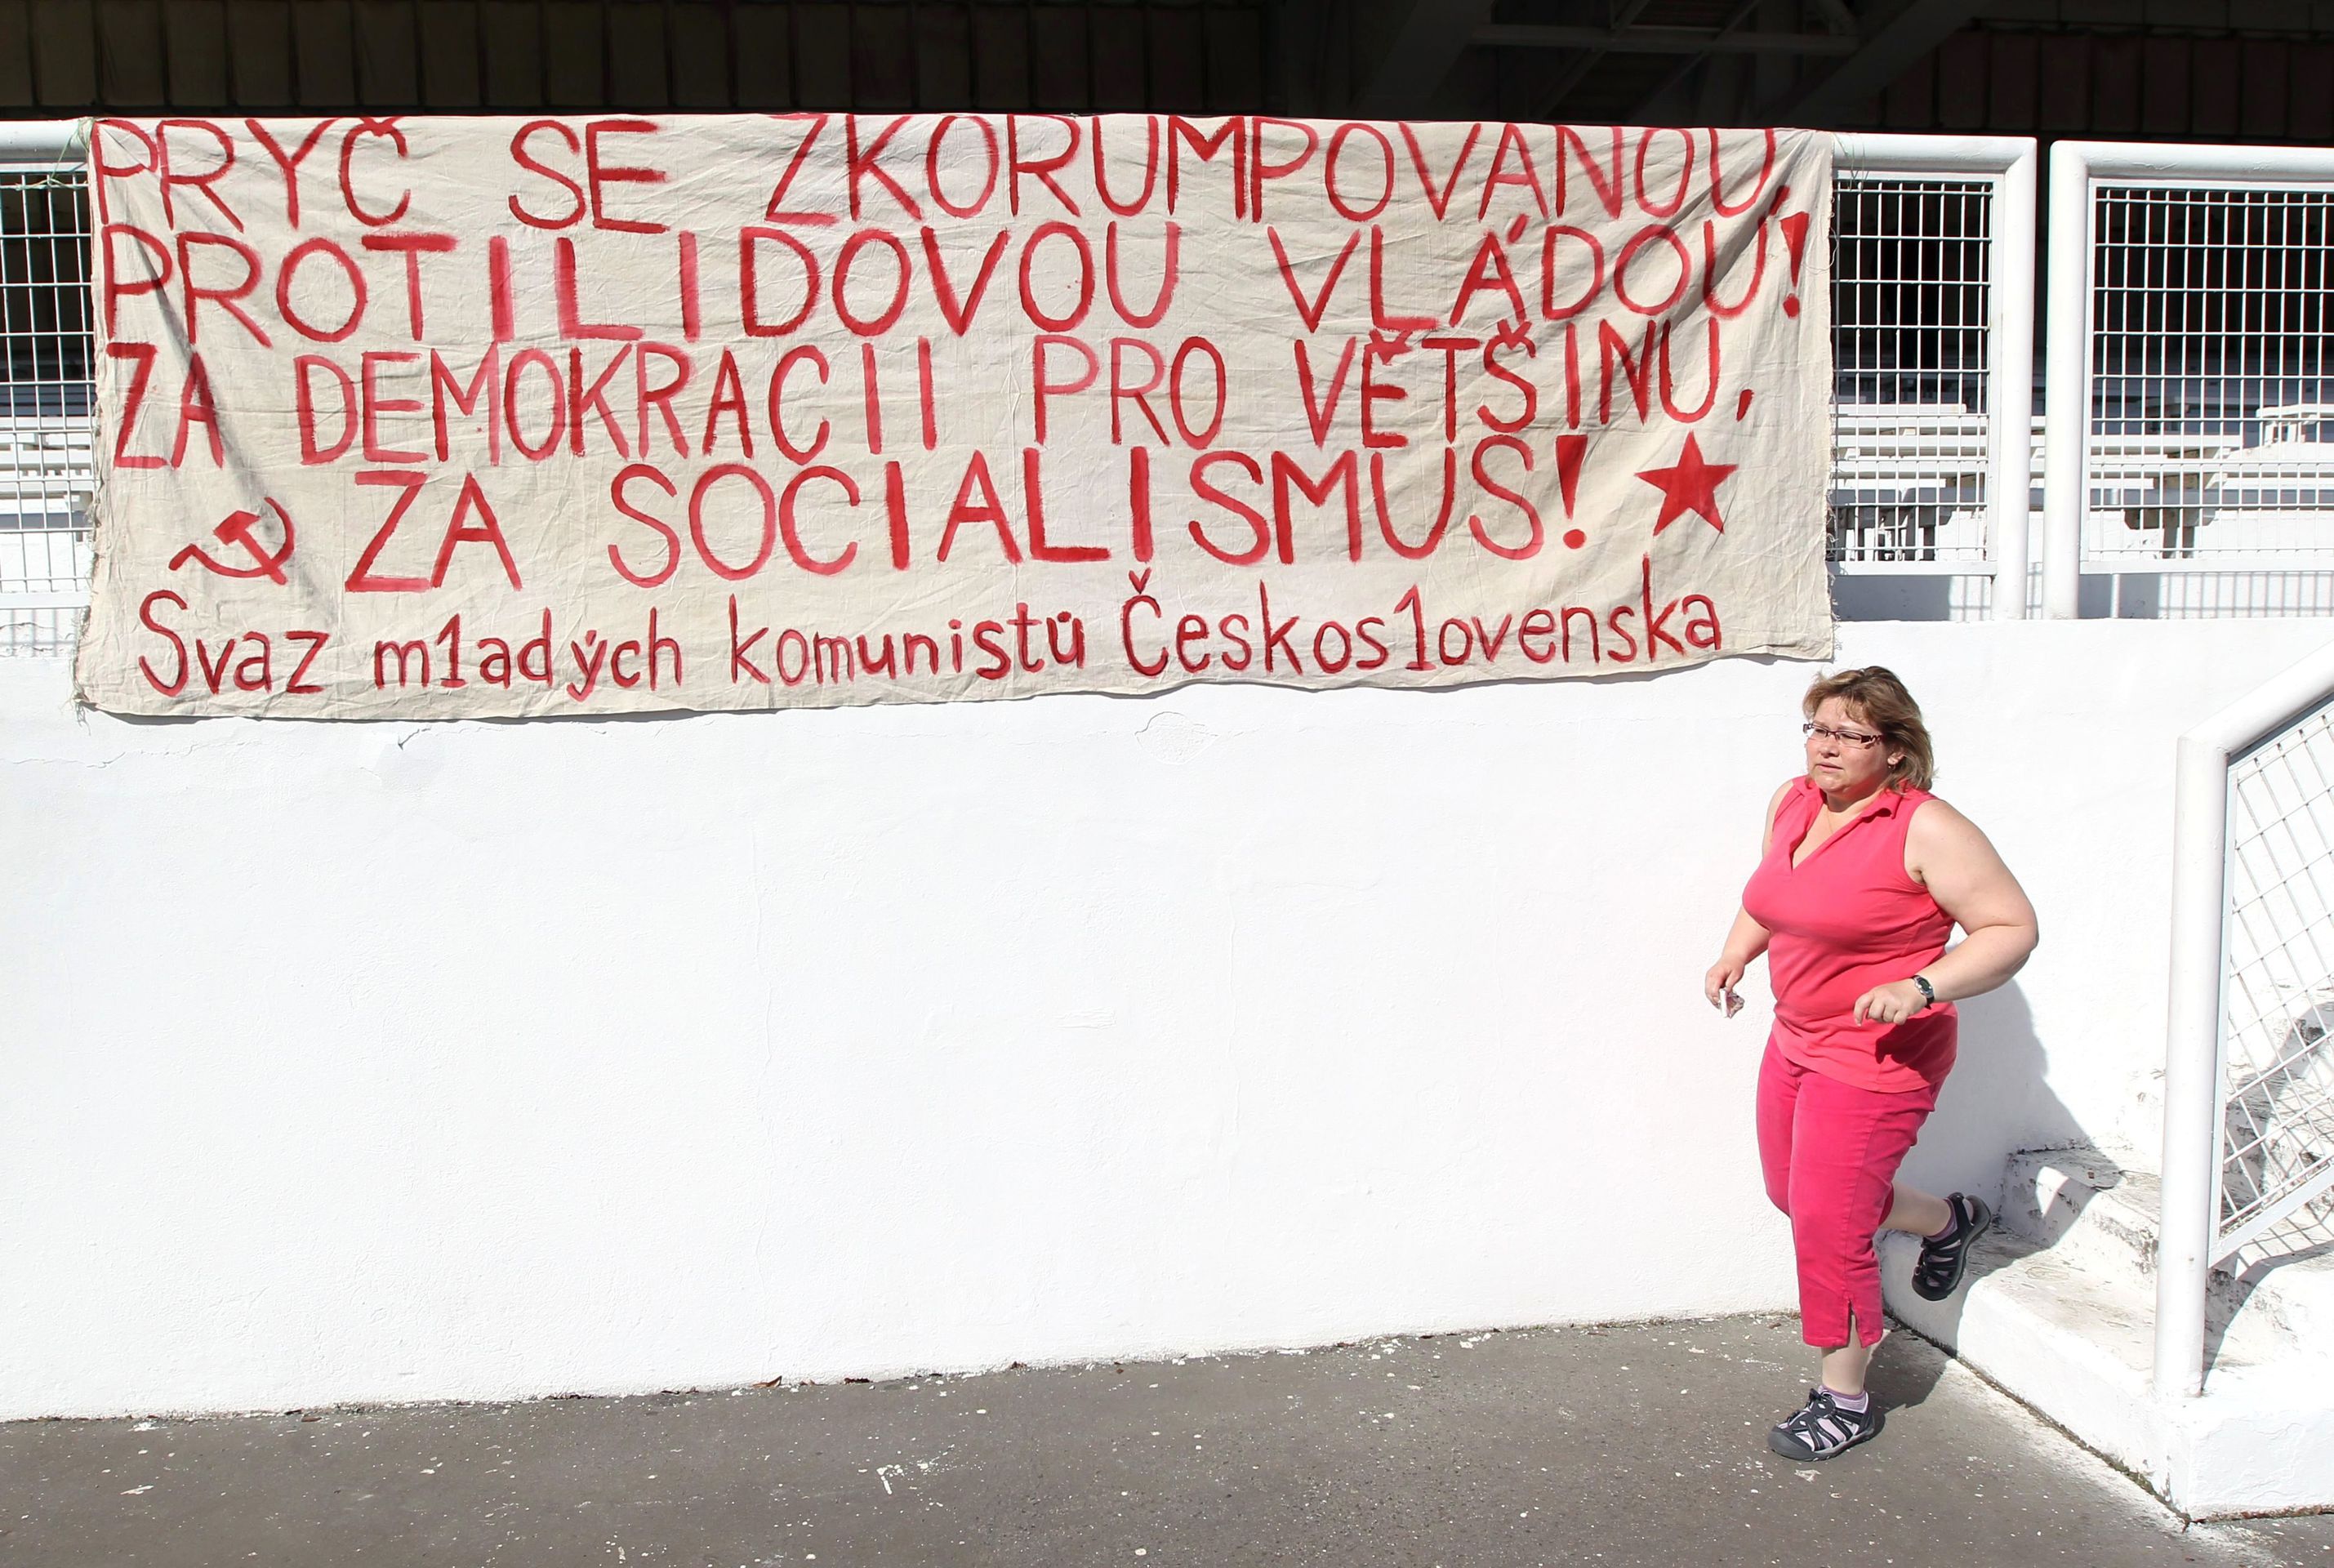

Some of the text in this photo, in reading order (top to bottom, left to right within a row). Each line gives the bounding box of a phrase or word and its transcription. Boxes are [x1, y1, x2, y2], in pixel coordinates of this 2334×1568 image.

[91, 115, 409, 231] PRYČ
[510, 120, 669, 234] SE
[102, 212, 1809, 348] PROTILIDOVOU VLÁDOU!
[106, 342, 223, 469] ZA
[295, 337, 937, 466] DEMOKRACII
[1033, 335, 1226, 450] PRO
[345, 434, 1588, 592] ZA SOCIALISMUS!
[140, 590, 329, 697] Svaz
